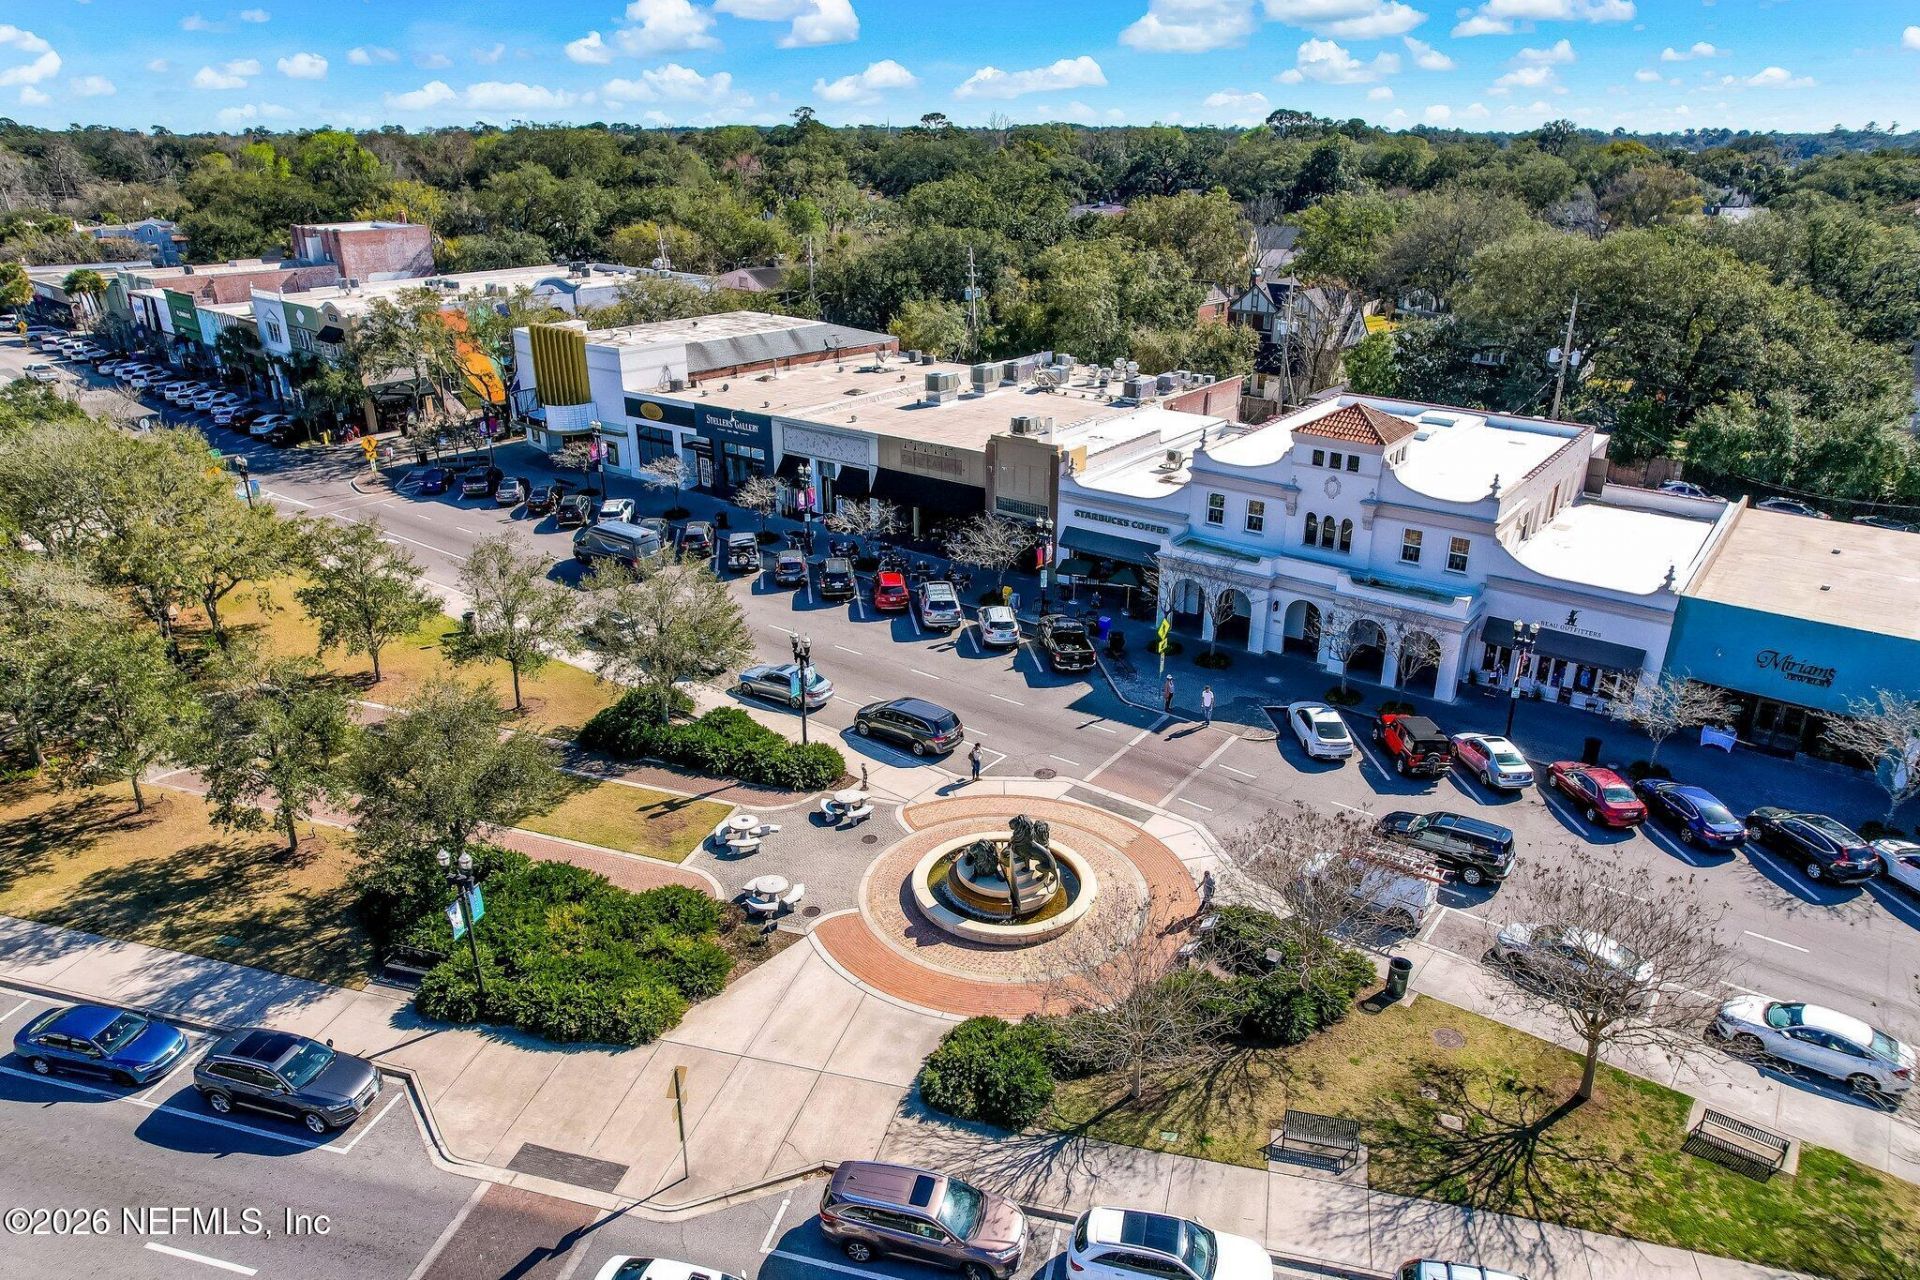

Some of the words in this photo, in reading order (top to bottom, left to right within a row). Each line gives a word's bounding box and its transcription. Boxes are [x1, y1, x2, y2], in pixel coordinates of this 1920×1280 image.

[706, 413, 733, 428] STELLERS
[734, 419, 759, 433] GALLERY
[1074, 509, 1130, 528] STARBUCKS
[1131, 521, 1170, 535] COFFEE
[1540, 620, 1559, 630] BEAU
[1560, 625, 1602, 638] OUTFITTERS
